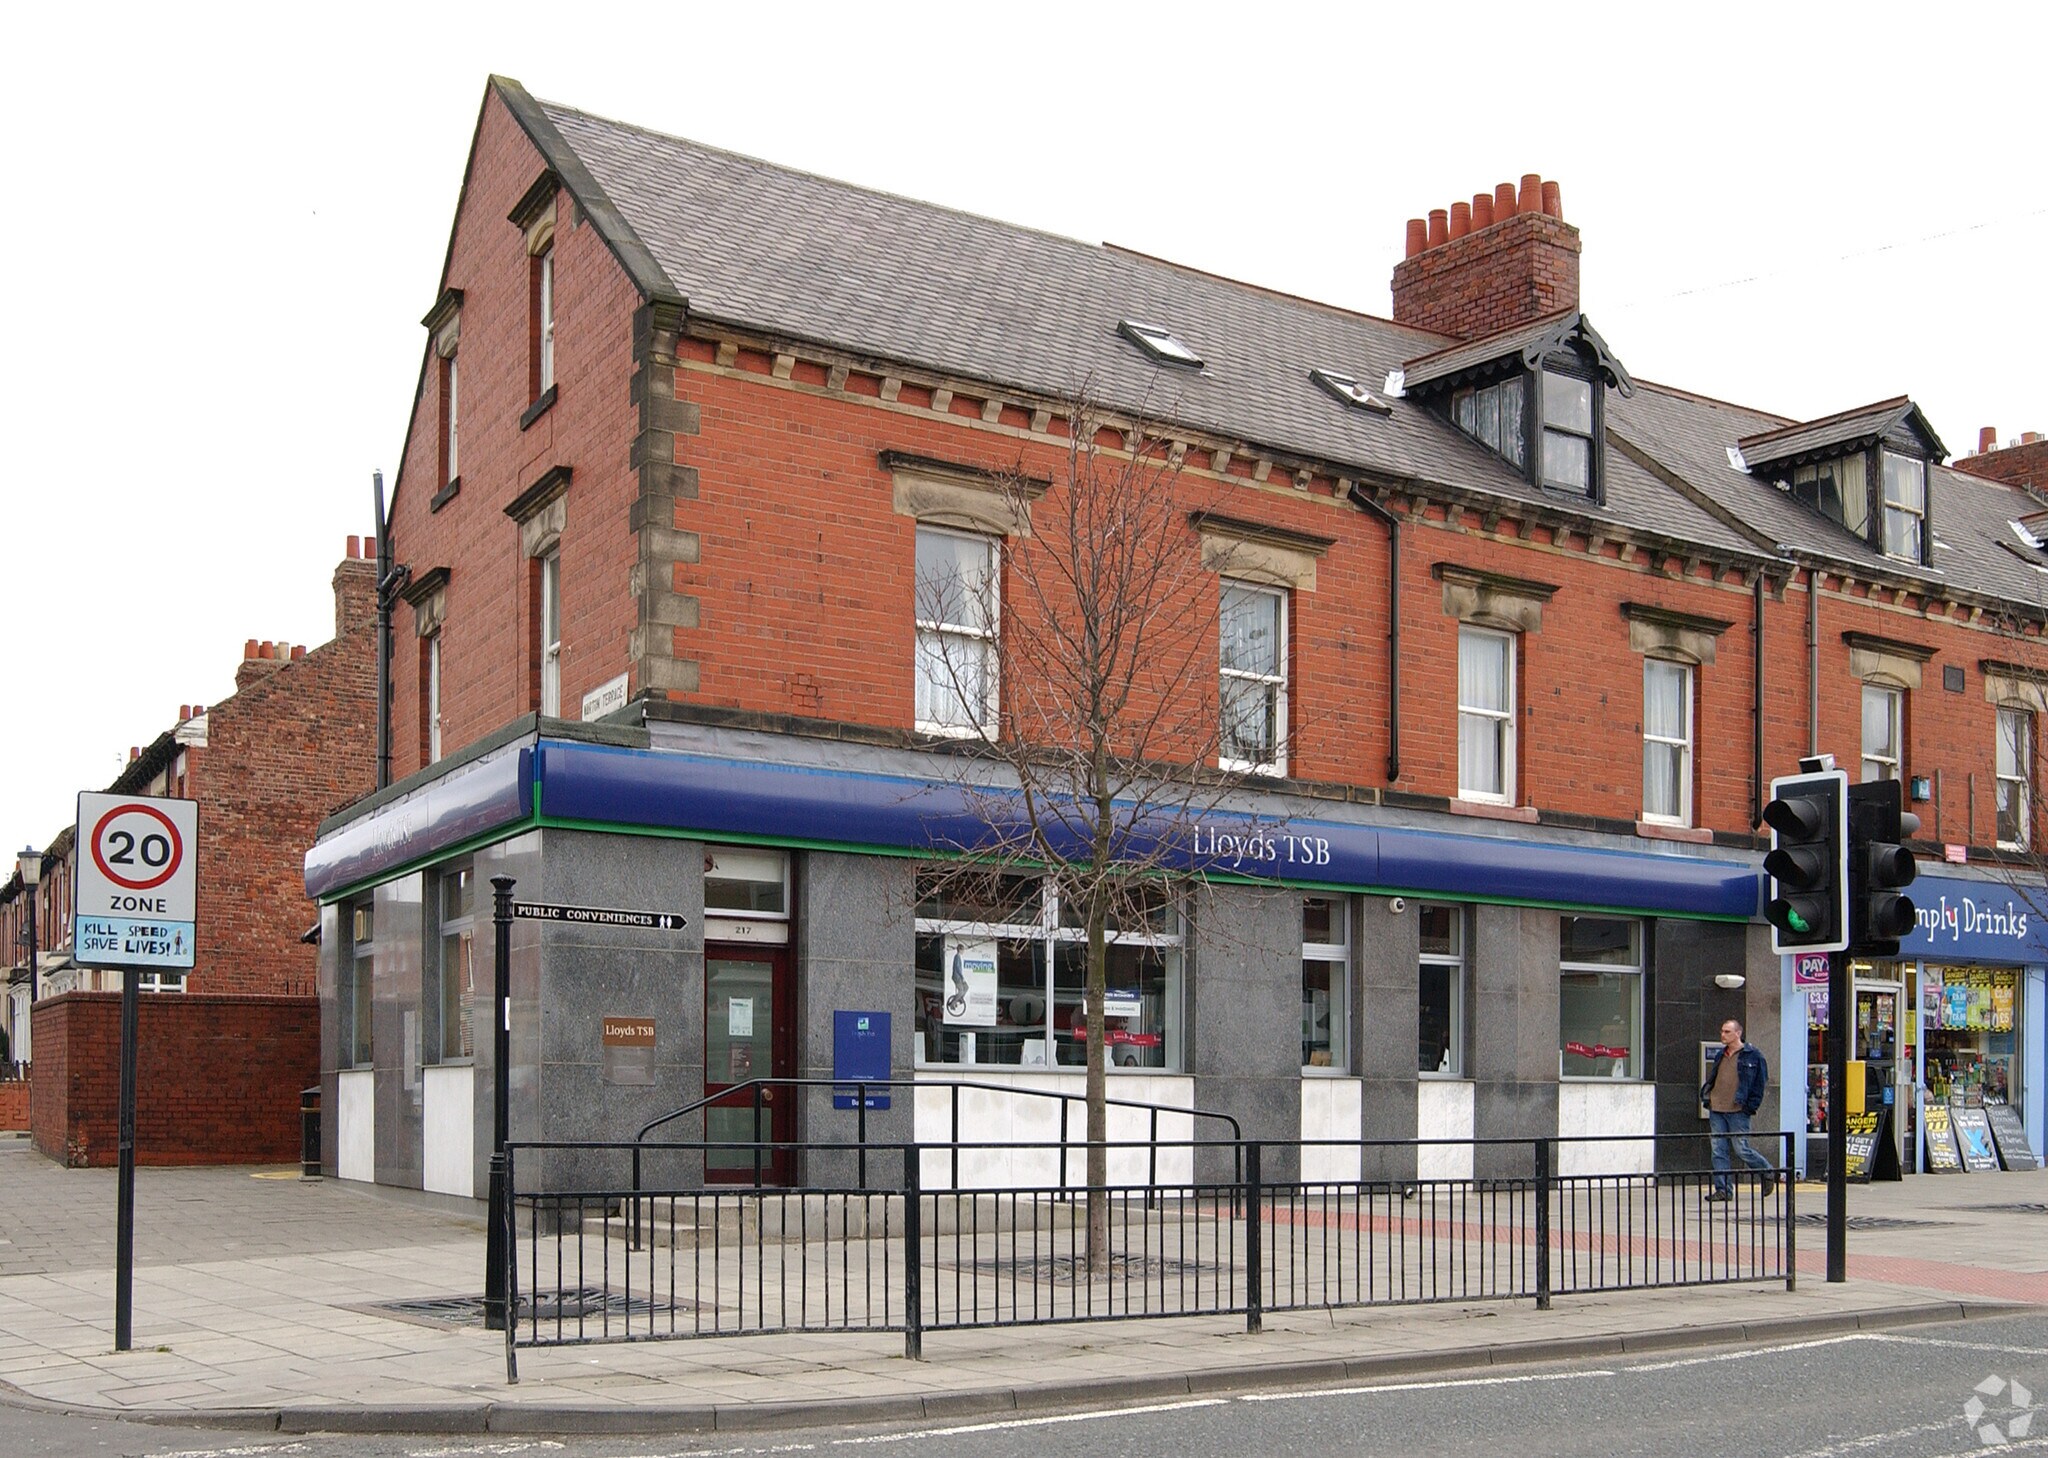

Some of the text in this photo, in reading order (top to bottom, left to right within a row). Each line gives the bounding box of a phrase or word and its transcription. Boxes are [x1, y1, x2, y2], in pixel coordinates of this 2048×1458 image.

[108, 831, 170, 867] 20
[1194, 825, 1330, 867] Lloyds TSB
[110, 896, 166, 913] ZONE
[518, 906, 653, 925] PUBLIC CONVENIENCES
[1914, 896, 2027, 942] mply Drinks
[84, 923, 168, 938] KILL SPEED
[735, 926, 752, 935] 217
[84, 937, 171, 956] SAVE LIVES!
[1809, 992, 1829, 1004] £3.9
[606, 1025, 654, 1038] Lloyds TSB
[1846, 1115, 1878, 1126] ANGER!
